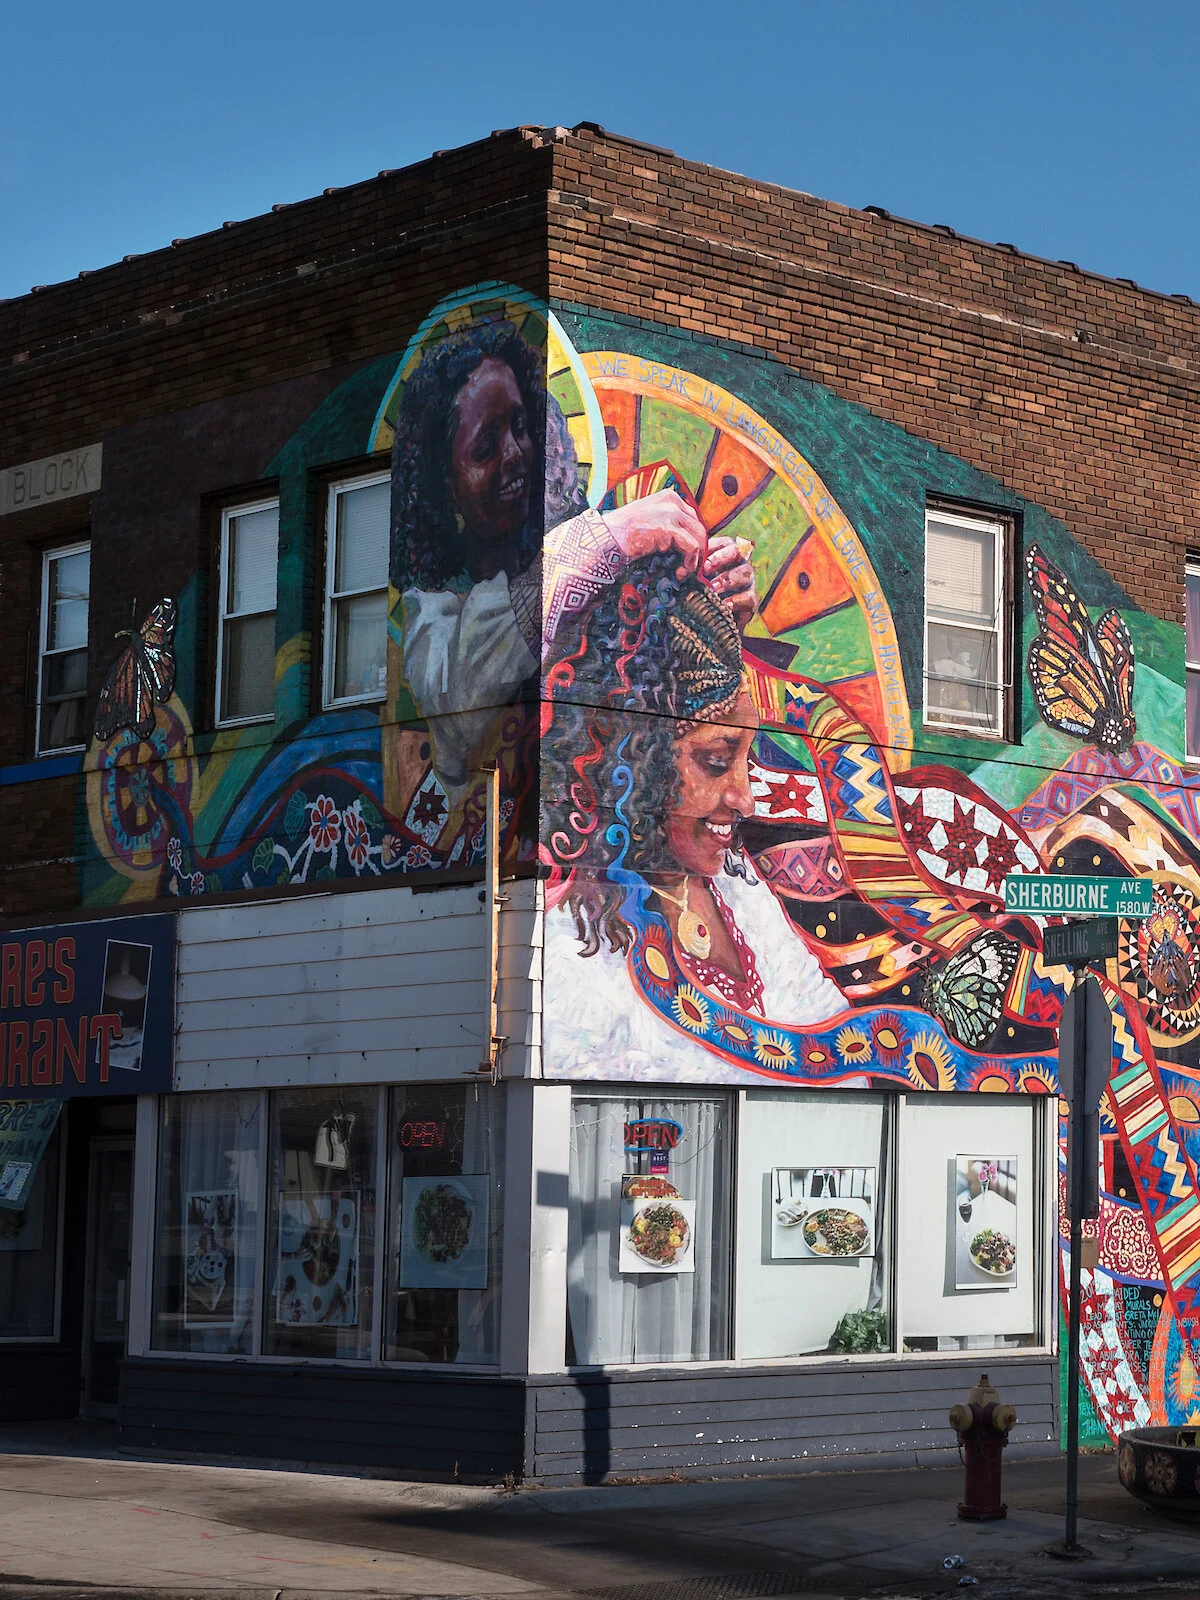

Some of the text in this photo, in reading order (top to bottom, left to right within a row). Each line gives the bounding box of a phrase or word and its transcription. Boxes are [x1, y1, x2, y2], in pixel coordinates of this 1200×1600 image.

[14, 452, 89, 504] BLOCK
[595, 354, 908, 755] WE SPEAK IN LANGUAGES OF LOVE AND HOMELAND
[1007, 881, 1142, 909] SHERBURNE AVE
[1116, 901, 1151, 914] 1580 W
[1044, 922, 1109, 959] SNELLING AVE
[401, 1122, 446, 1146] OPEN
